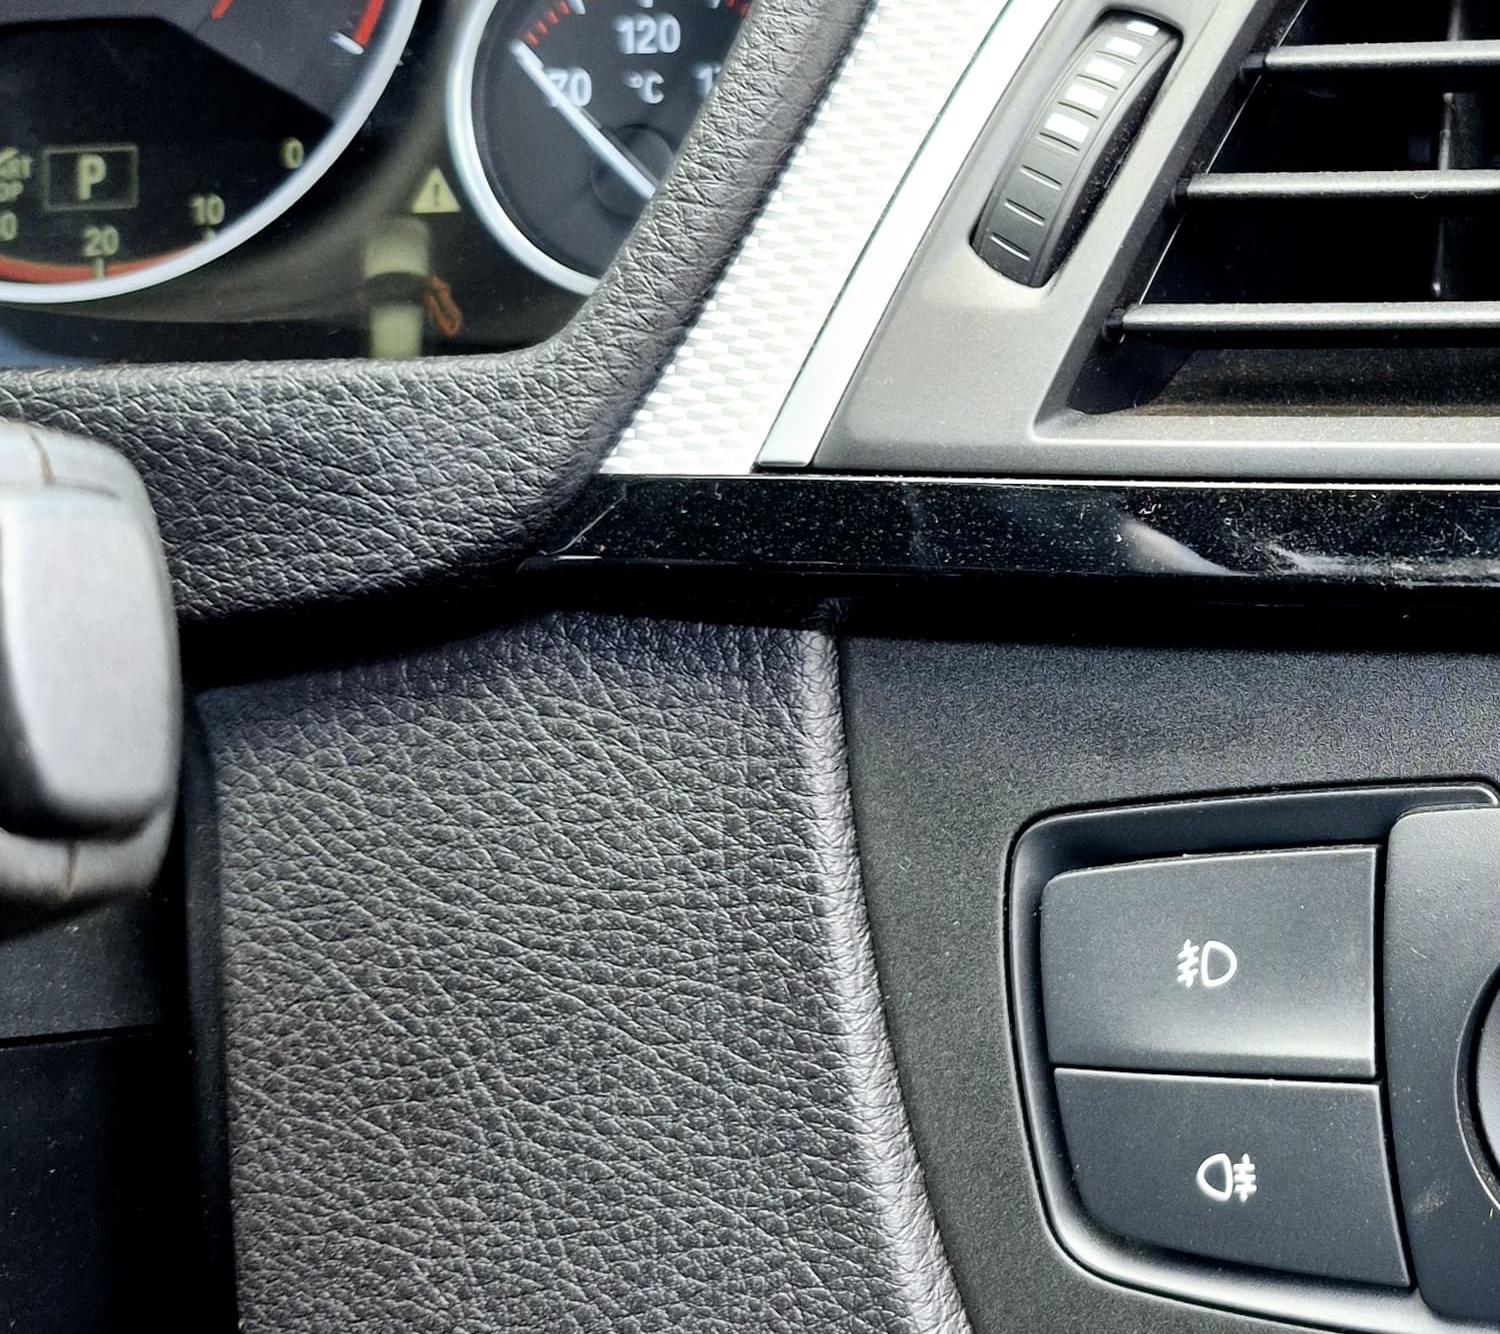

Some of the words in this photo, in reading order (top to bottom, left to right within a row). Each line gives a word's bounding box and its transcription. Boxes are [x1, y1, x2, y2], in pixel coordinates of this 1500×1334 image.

[613, 12, 681, 55] 120
[546, 67, 592, 107] 70
[76, 154, 107, 201] P
[190, 194, 226, 226] 10
[83, 225, 120, 257] 20
